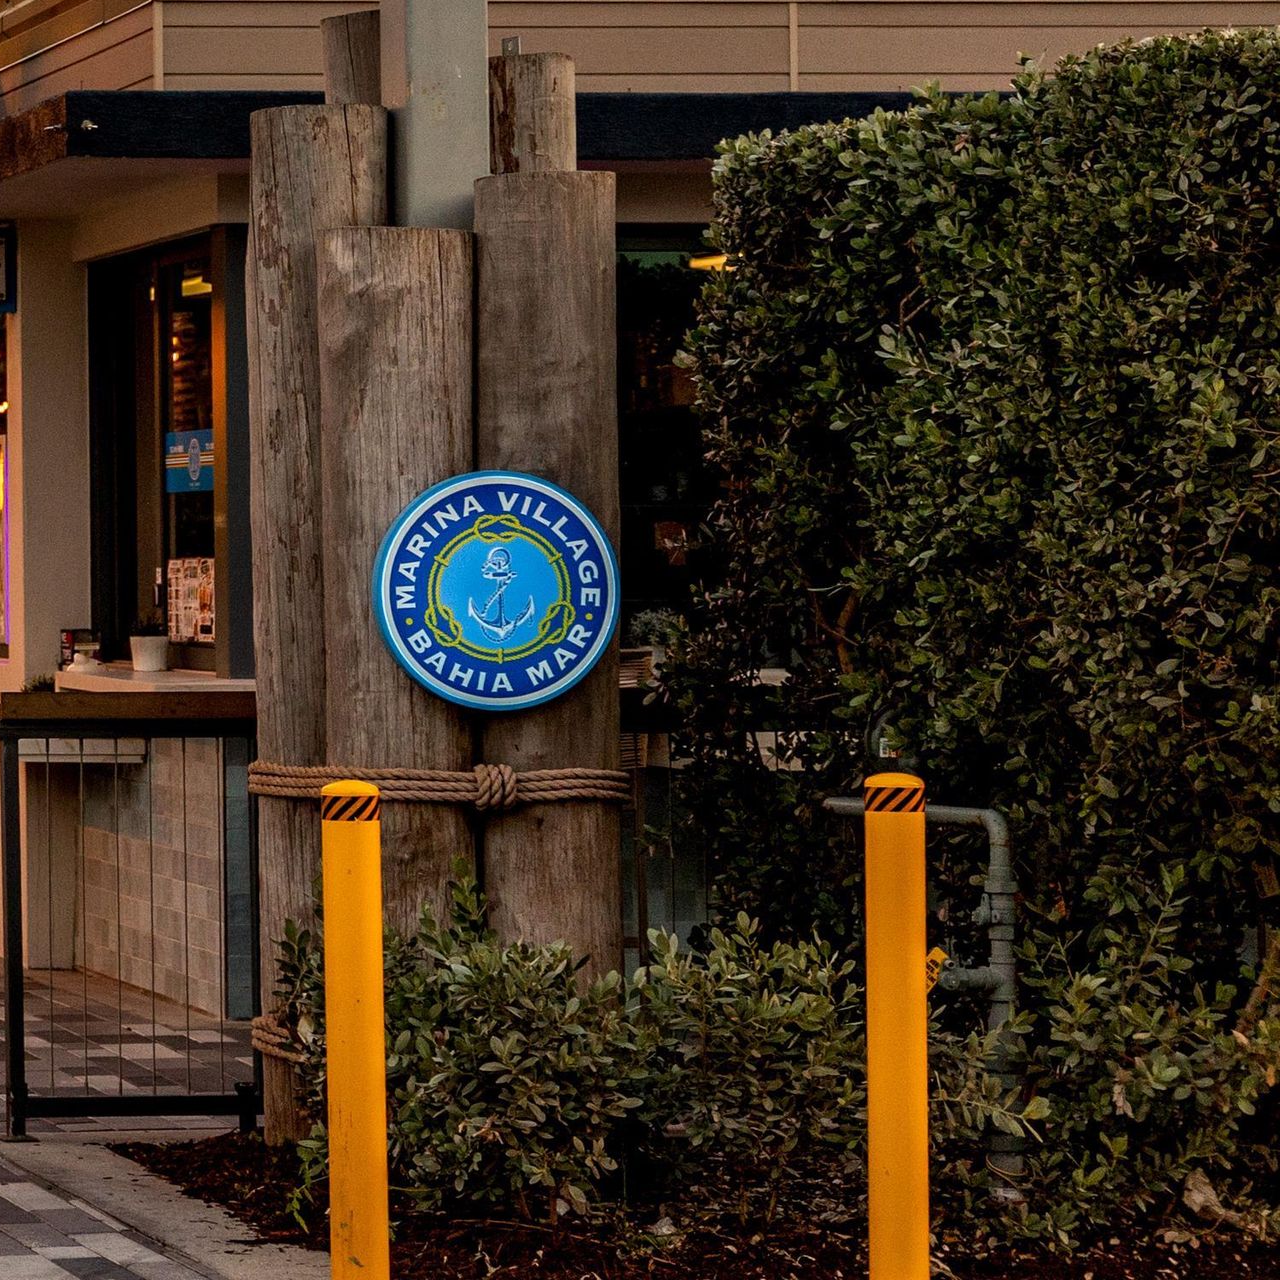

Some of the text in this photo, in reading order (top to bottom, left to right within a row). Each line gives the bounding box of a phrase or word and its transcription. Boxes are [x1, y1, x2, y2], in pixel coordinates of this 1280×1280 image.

[395, 491, 601, 610] MARINA VILLAGE
[407, 623, 592, 692] BAHIA MAR
